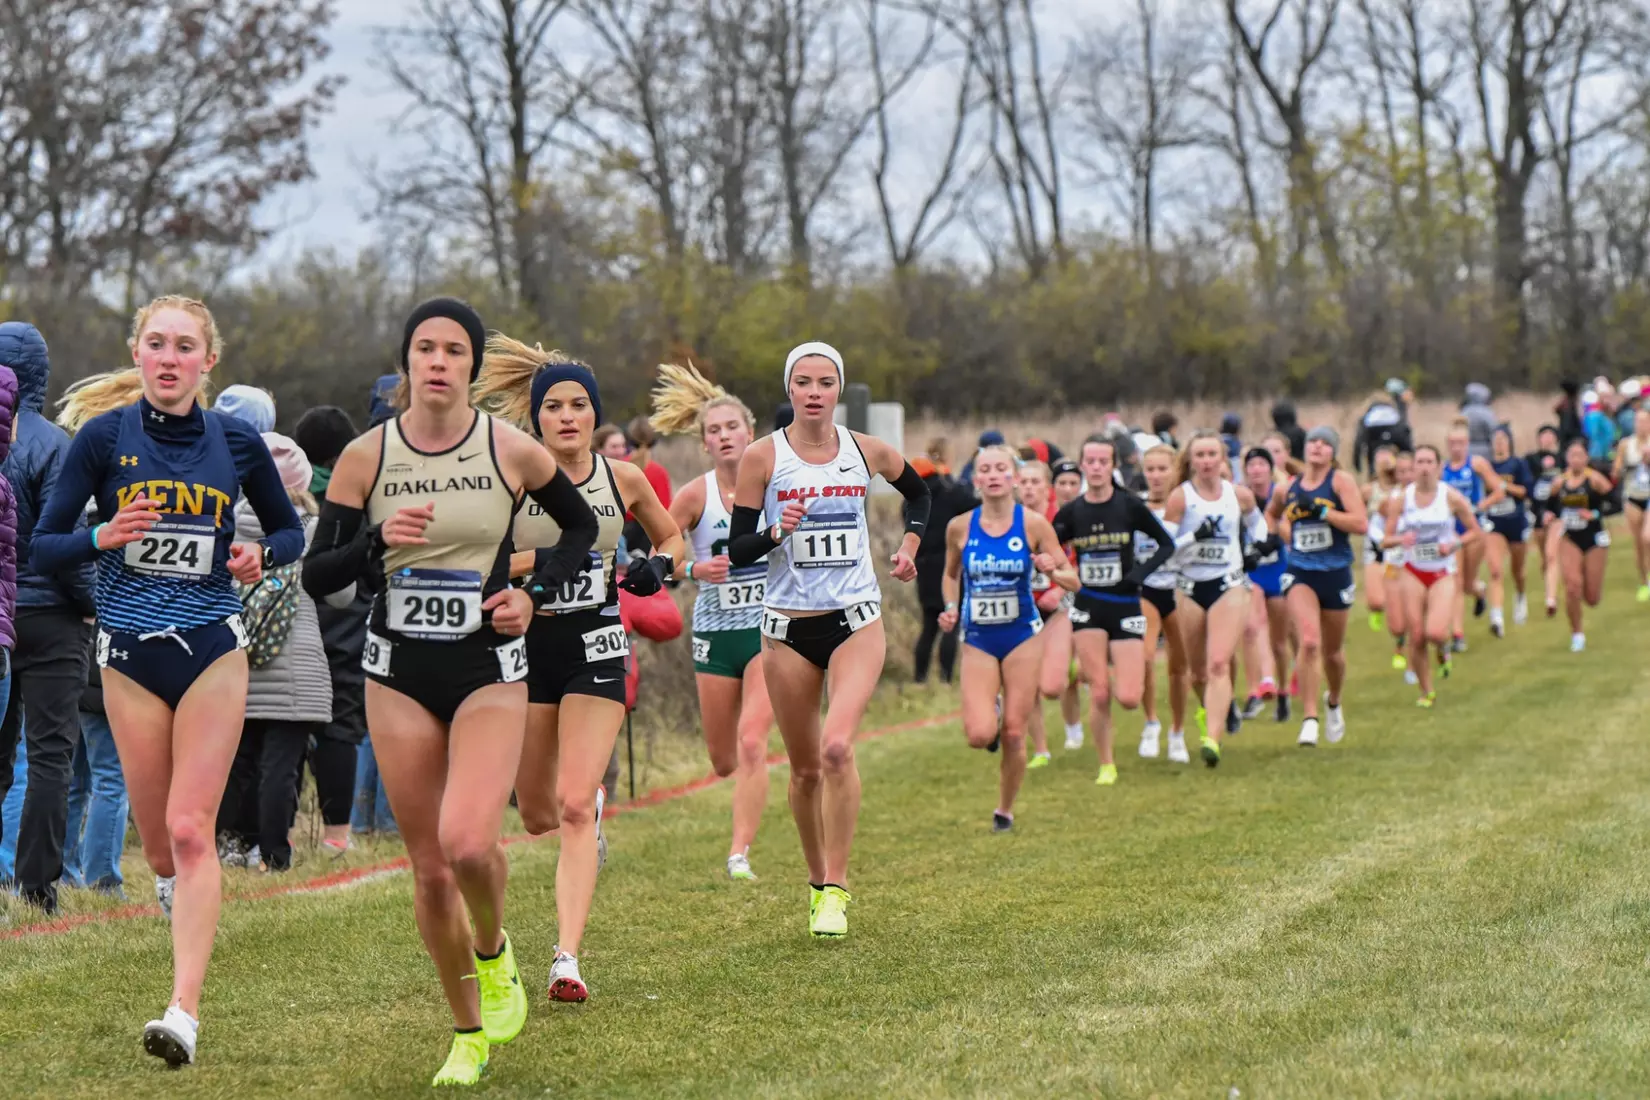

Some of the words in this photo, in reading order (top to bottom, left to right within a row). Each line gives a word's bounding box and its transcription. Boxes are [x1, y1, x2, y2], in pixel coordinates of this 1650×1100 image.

[384, 476, 492, 497] OAKLAND
[822, 486, 866, 497] STATE
[117, 480, 231, 528] KENT
[139, 537, 199, 568] 224
[805, 534, 847, 557] 111
[969, 552, 1024, 575] Indiana
[728, 584, 764, 605] 373
[404, 596, 466, 627] 299
[978, 601, 1008, 618] 211
